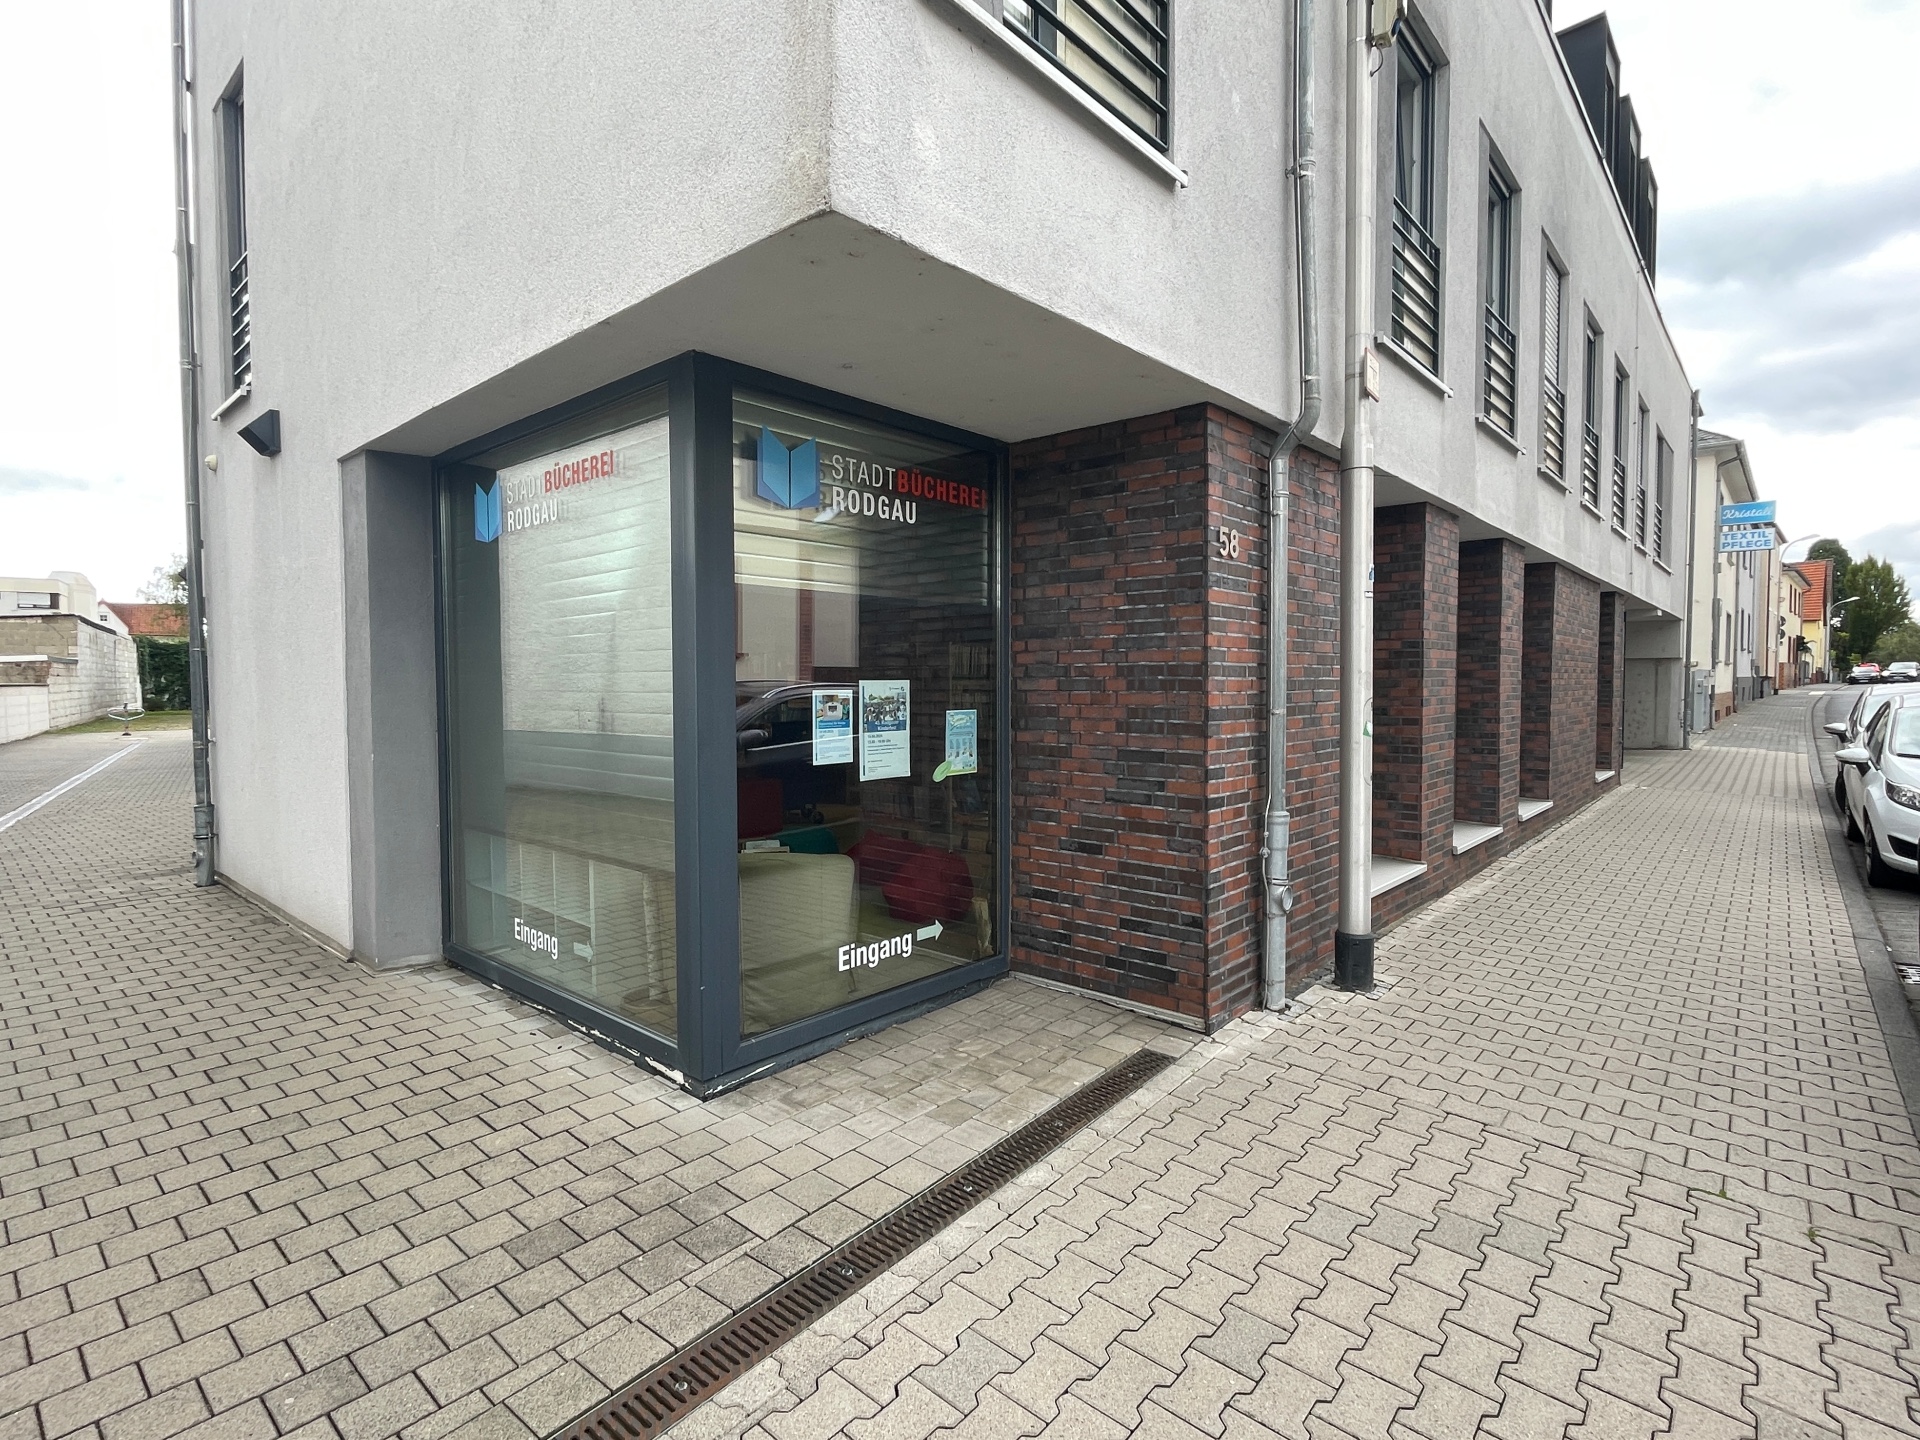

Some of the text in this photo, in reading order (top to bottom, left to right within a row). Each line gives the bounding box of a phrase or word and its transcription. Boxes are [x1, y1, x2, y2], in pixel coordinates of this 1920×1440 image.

[507, 498, 559, 533] RODGAU
[832, 486, 917, 524] RODGAU
[1721, 506, 1774, 520] Kristall
[1219, 525, 1240, 559] 58
[1721, 539, 1772, 550] PFLEGE
[1722, 530, 1773, 541] TEXTIL-
[514, 917, 559, 960] Eingang
[838, 933, 913, 972] Eingang
